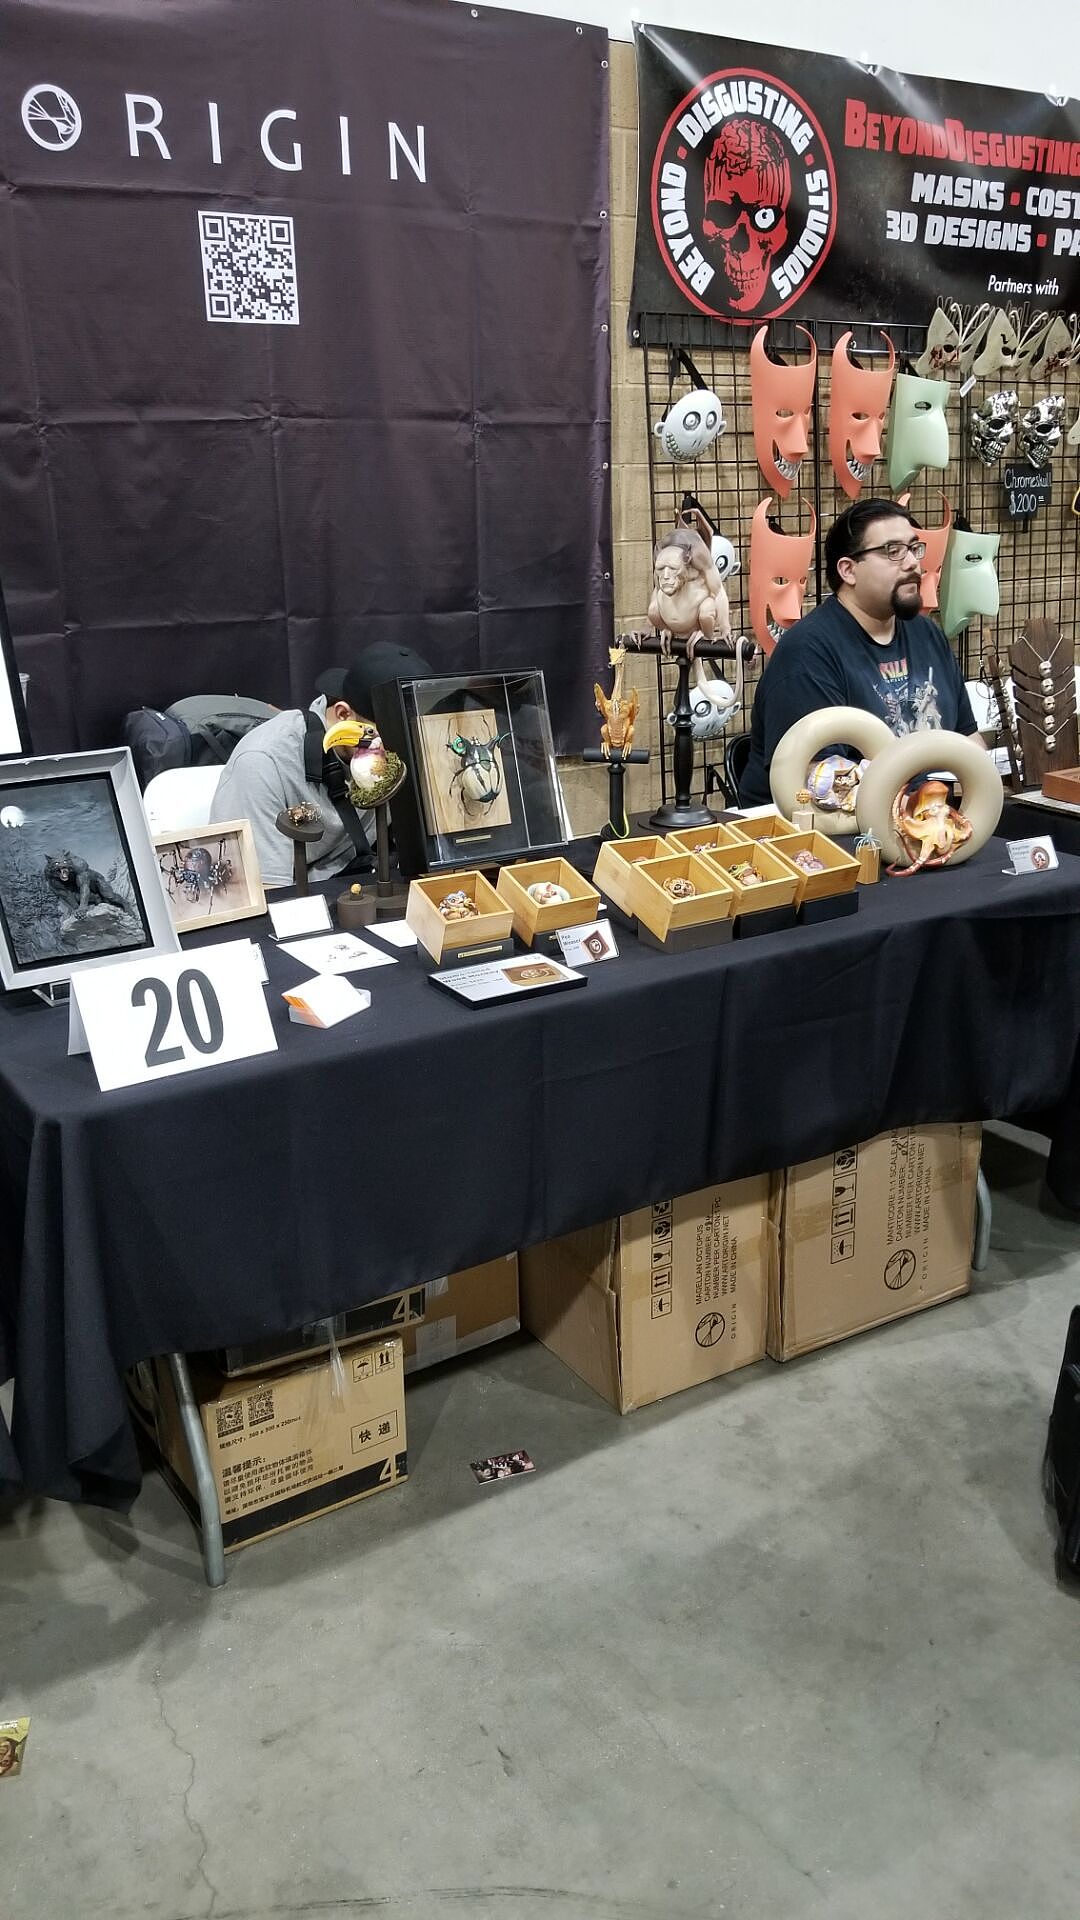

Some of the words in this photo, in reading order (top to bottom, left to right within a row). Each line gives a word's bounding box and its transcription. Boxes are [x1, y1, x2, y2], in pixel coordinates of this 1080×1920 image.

[21, 83, 428, 183] ORIGIN
[676, 81, 815, 155] DISGUSTING
[911, 171, 1005, 211] MASKS
[661, 162, 715, 296] BEYOND
[771, 169, 829, 300] STUDIOS
[885, 210, 918, 242] 3D
[924, 214, 1031, 253] DESIGNS
[988, 274, 1032, 294] Partners
[1035, 277, 1059, 296] with
[1004, 468, 1052, 489] Chromeskull
[131, 968, 224, 1068] 20
[924, 1166, 932, 1194] CHINA
[896, 1205, 904, 1242] CARTON
[922, 1207, 930, 1232] MADE
[695, 1224, 704, 1263] OCTOPUS
[730, 1236, 738, 1261] CHINA
[695, 1264, 703, 1305] MAGELLAN
[359, 1420, 390, 1443] 快递
